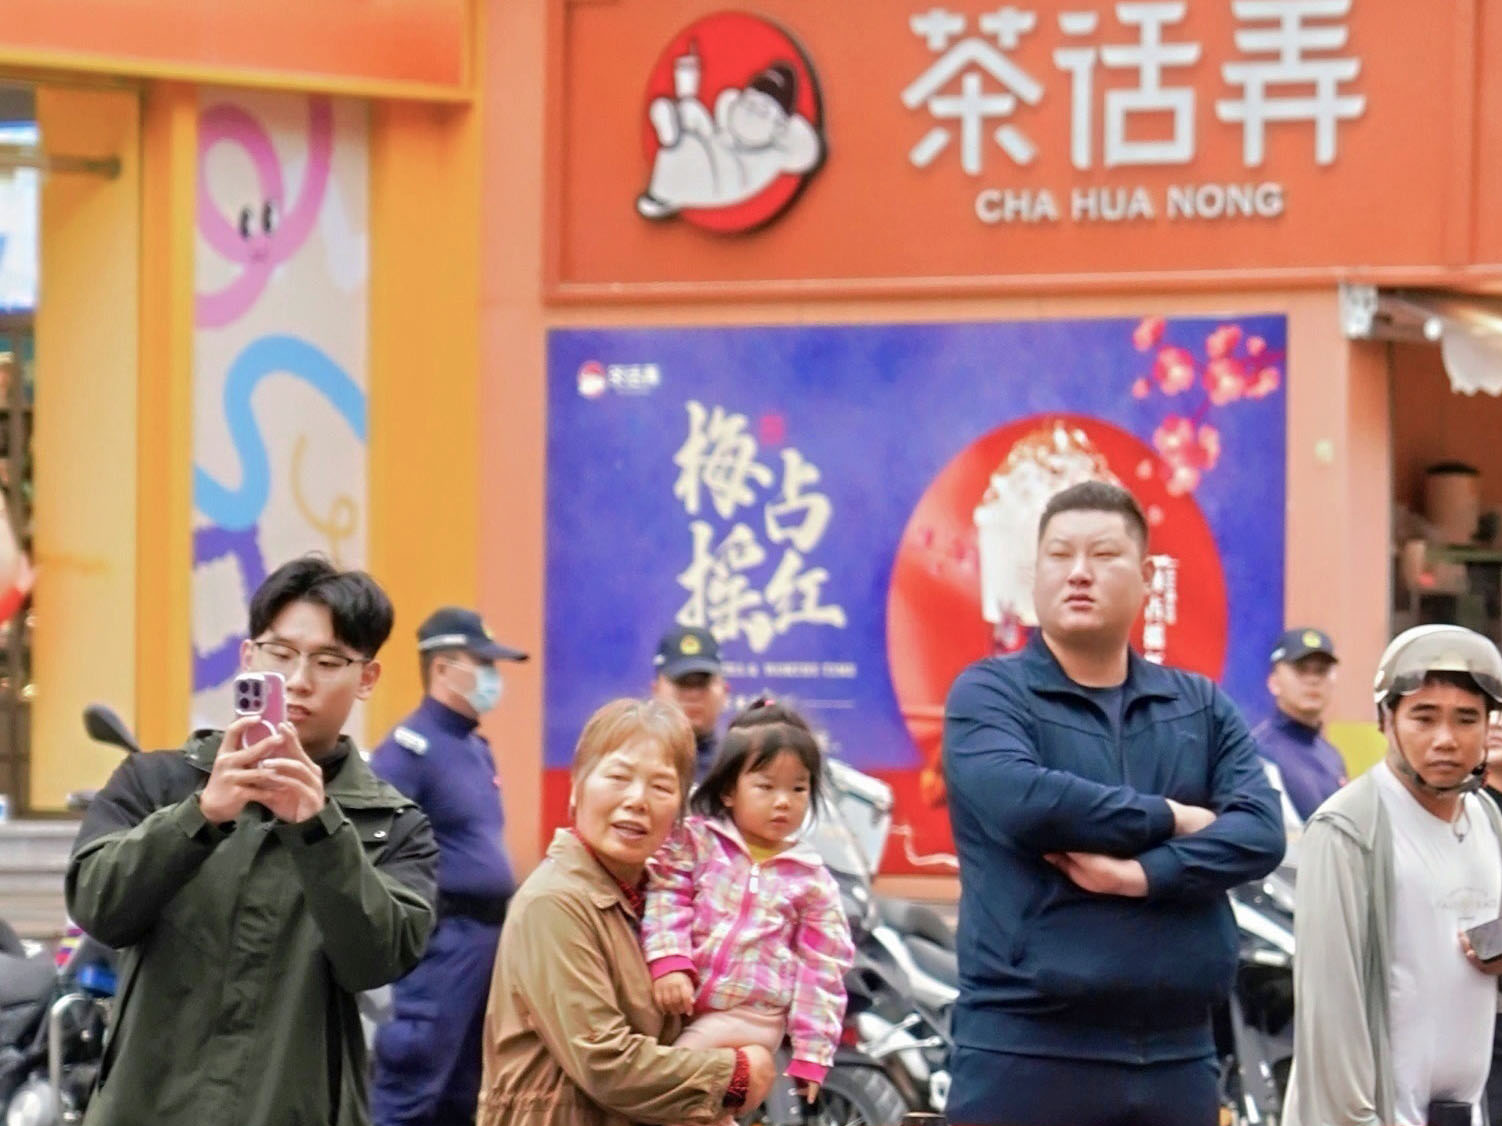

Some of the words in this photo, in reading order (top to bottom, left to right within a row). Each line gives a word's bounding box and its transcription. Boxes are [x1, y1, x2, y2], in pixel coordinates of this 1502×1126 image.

[901, 0, 1368, 176] 茶话弄
[974, 188, 1059, 224] CHA
[1071, 186, 1155, 221] HUA
[1167, 182, 1285, 218] NONG
